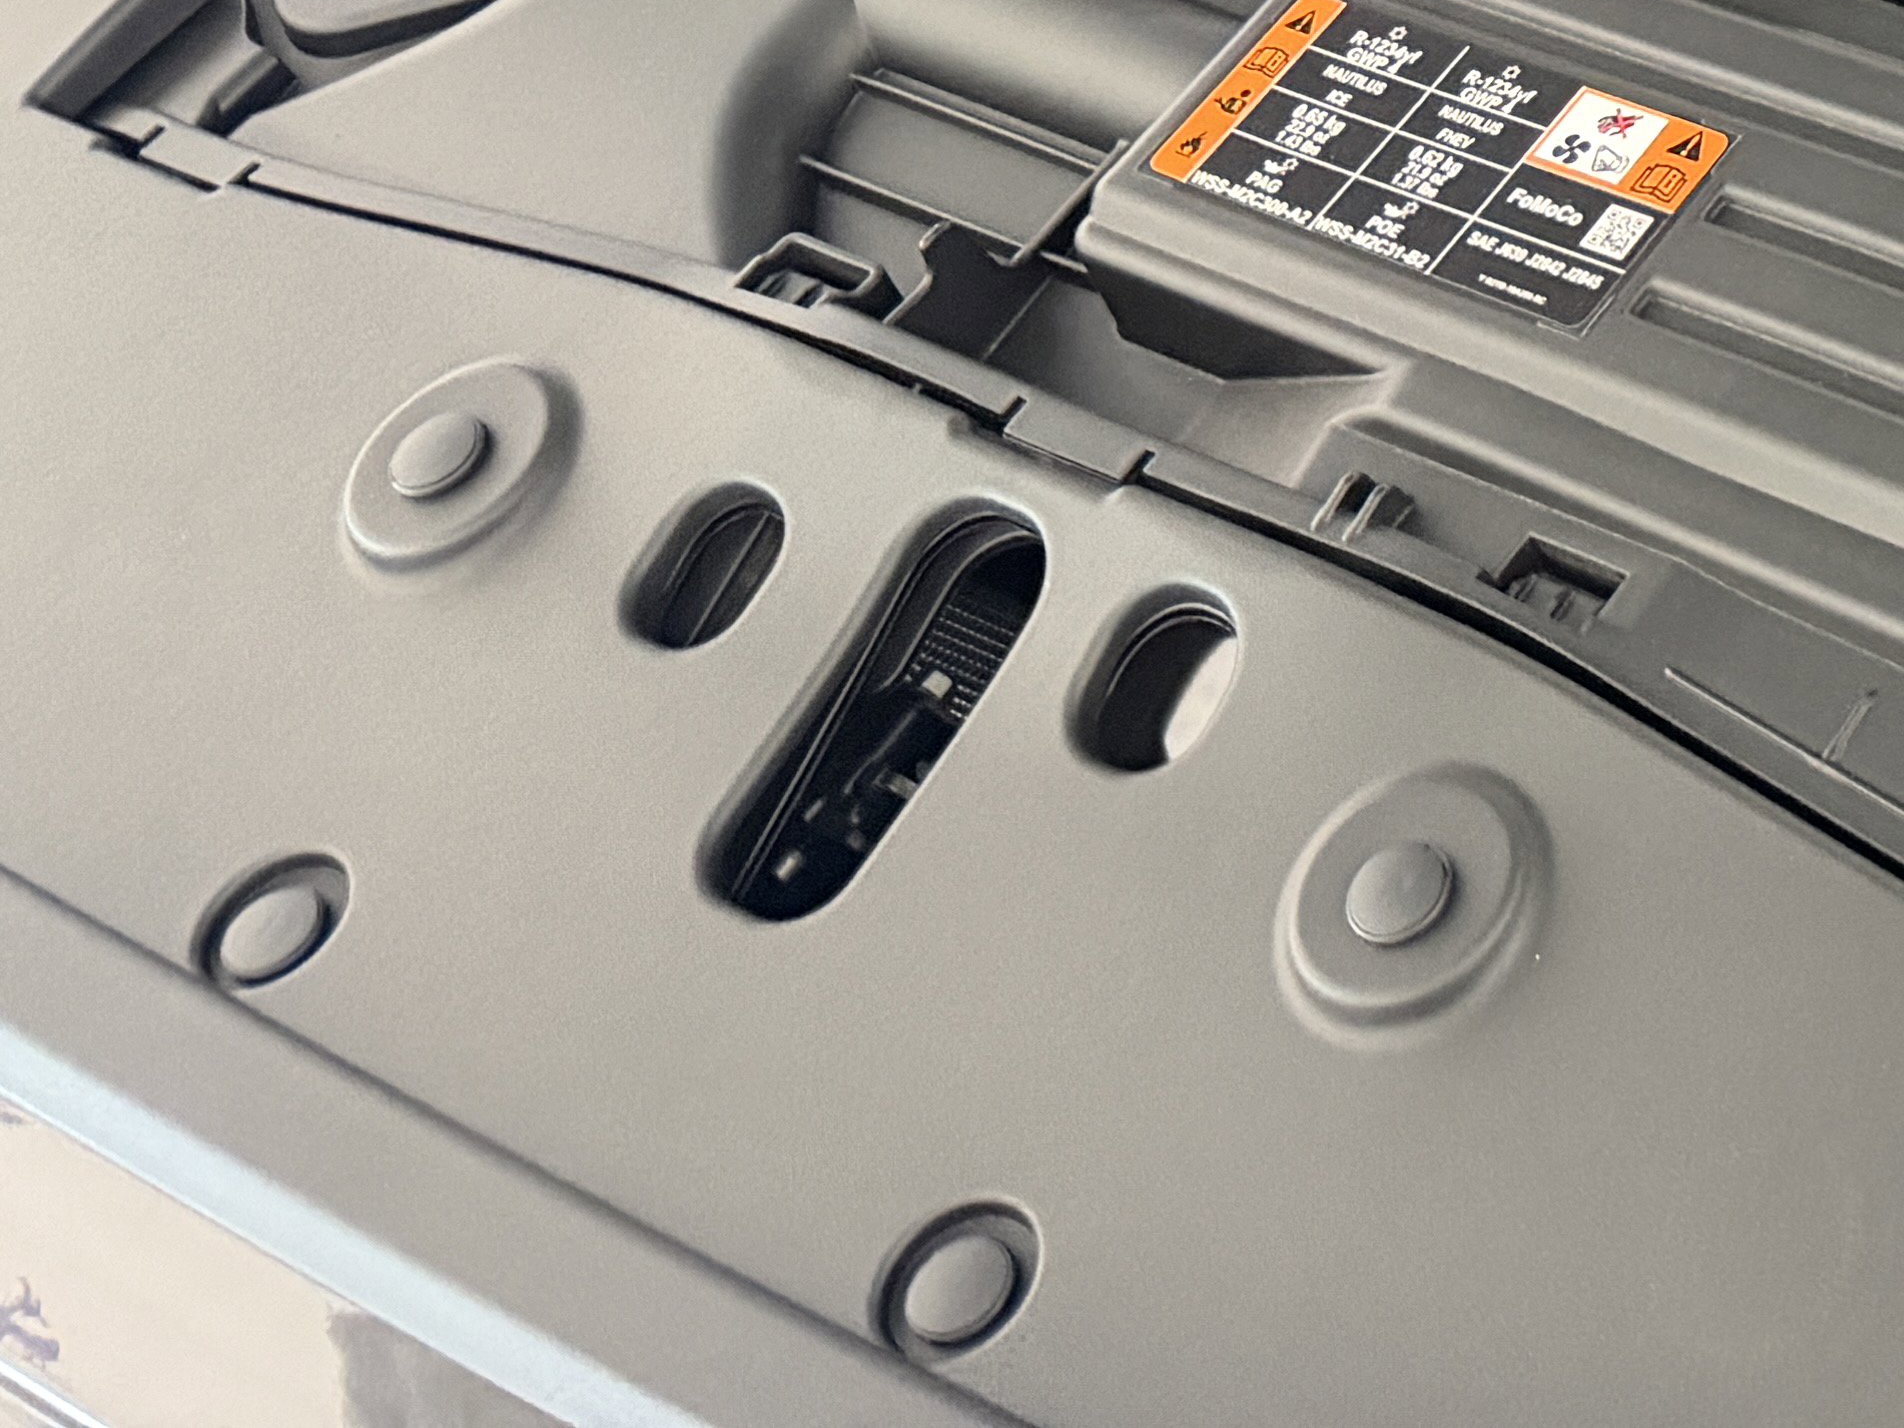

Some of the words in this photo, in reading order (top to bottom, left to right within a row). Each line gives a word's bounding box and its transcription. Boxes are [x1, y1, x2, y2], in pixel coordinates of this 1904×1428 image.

[1346, 47, 1387, 69] GWP
[1350, 30, 1423, 64] R-1234yf
[1322, 64, 1388, 95] NAUTILUS
[1462, 69, 1538, 104] R-1234yf
[1325, 89, 1353, 107] ICE
[1460, 87, 1502, 108] GWP
[1291, 104, 1328, 128] 0.65
[1325, 115, 1347, 136] kg
[1438, 105, 1504, 136] NAUTILUS
[1436, 127, 1476, 149] FHEV
[1444, 156, 1464, 178] kg
[1245, 170, 1284, 194] PAG
[1506, 187, 1584, 226] FoMoCo
[1365, 214, 1403, 240] POE
[1467, 230, 1500, 252] SAE
